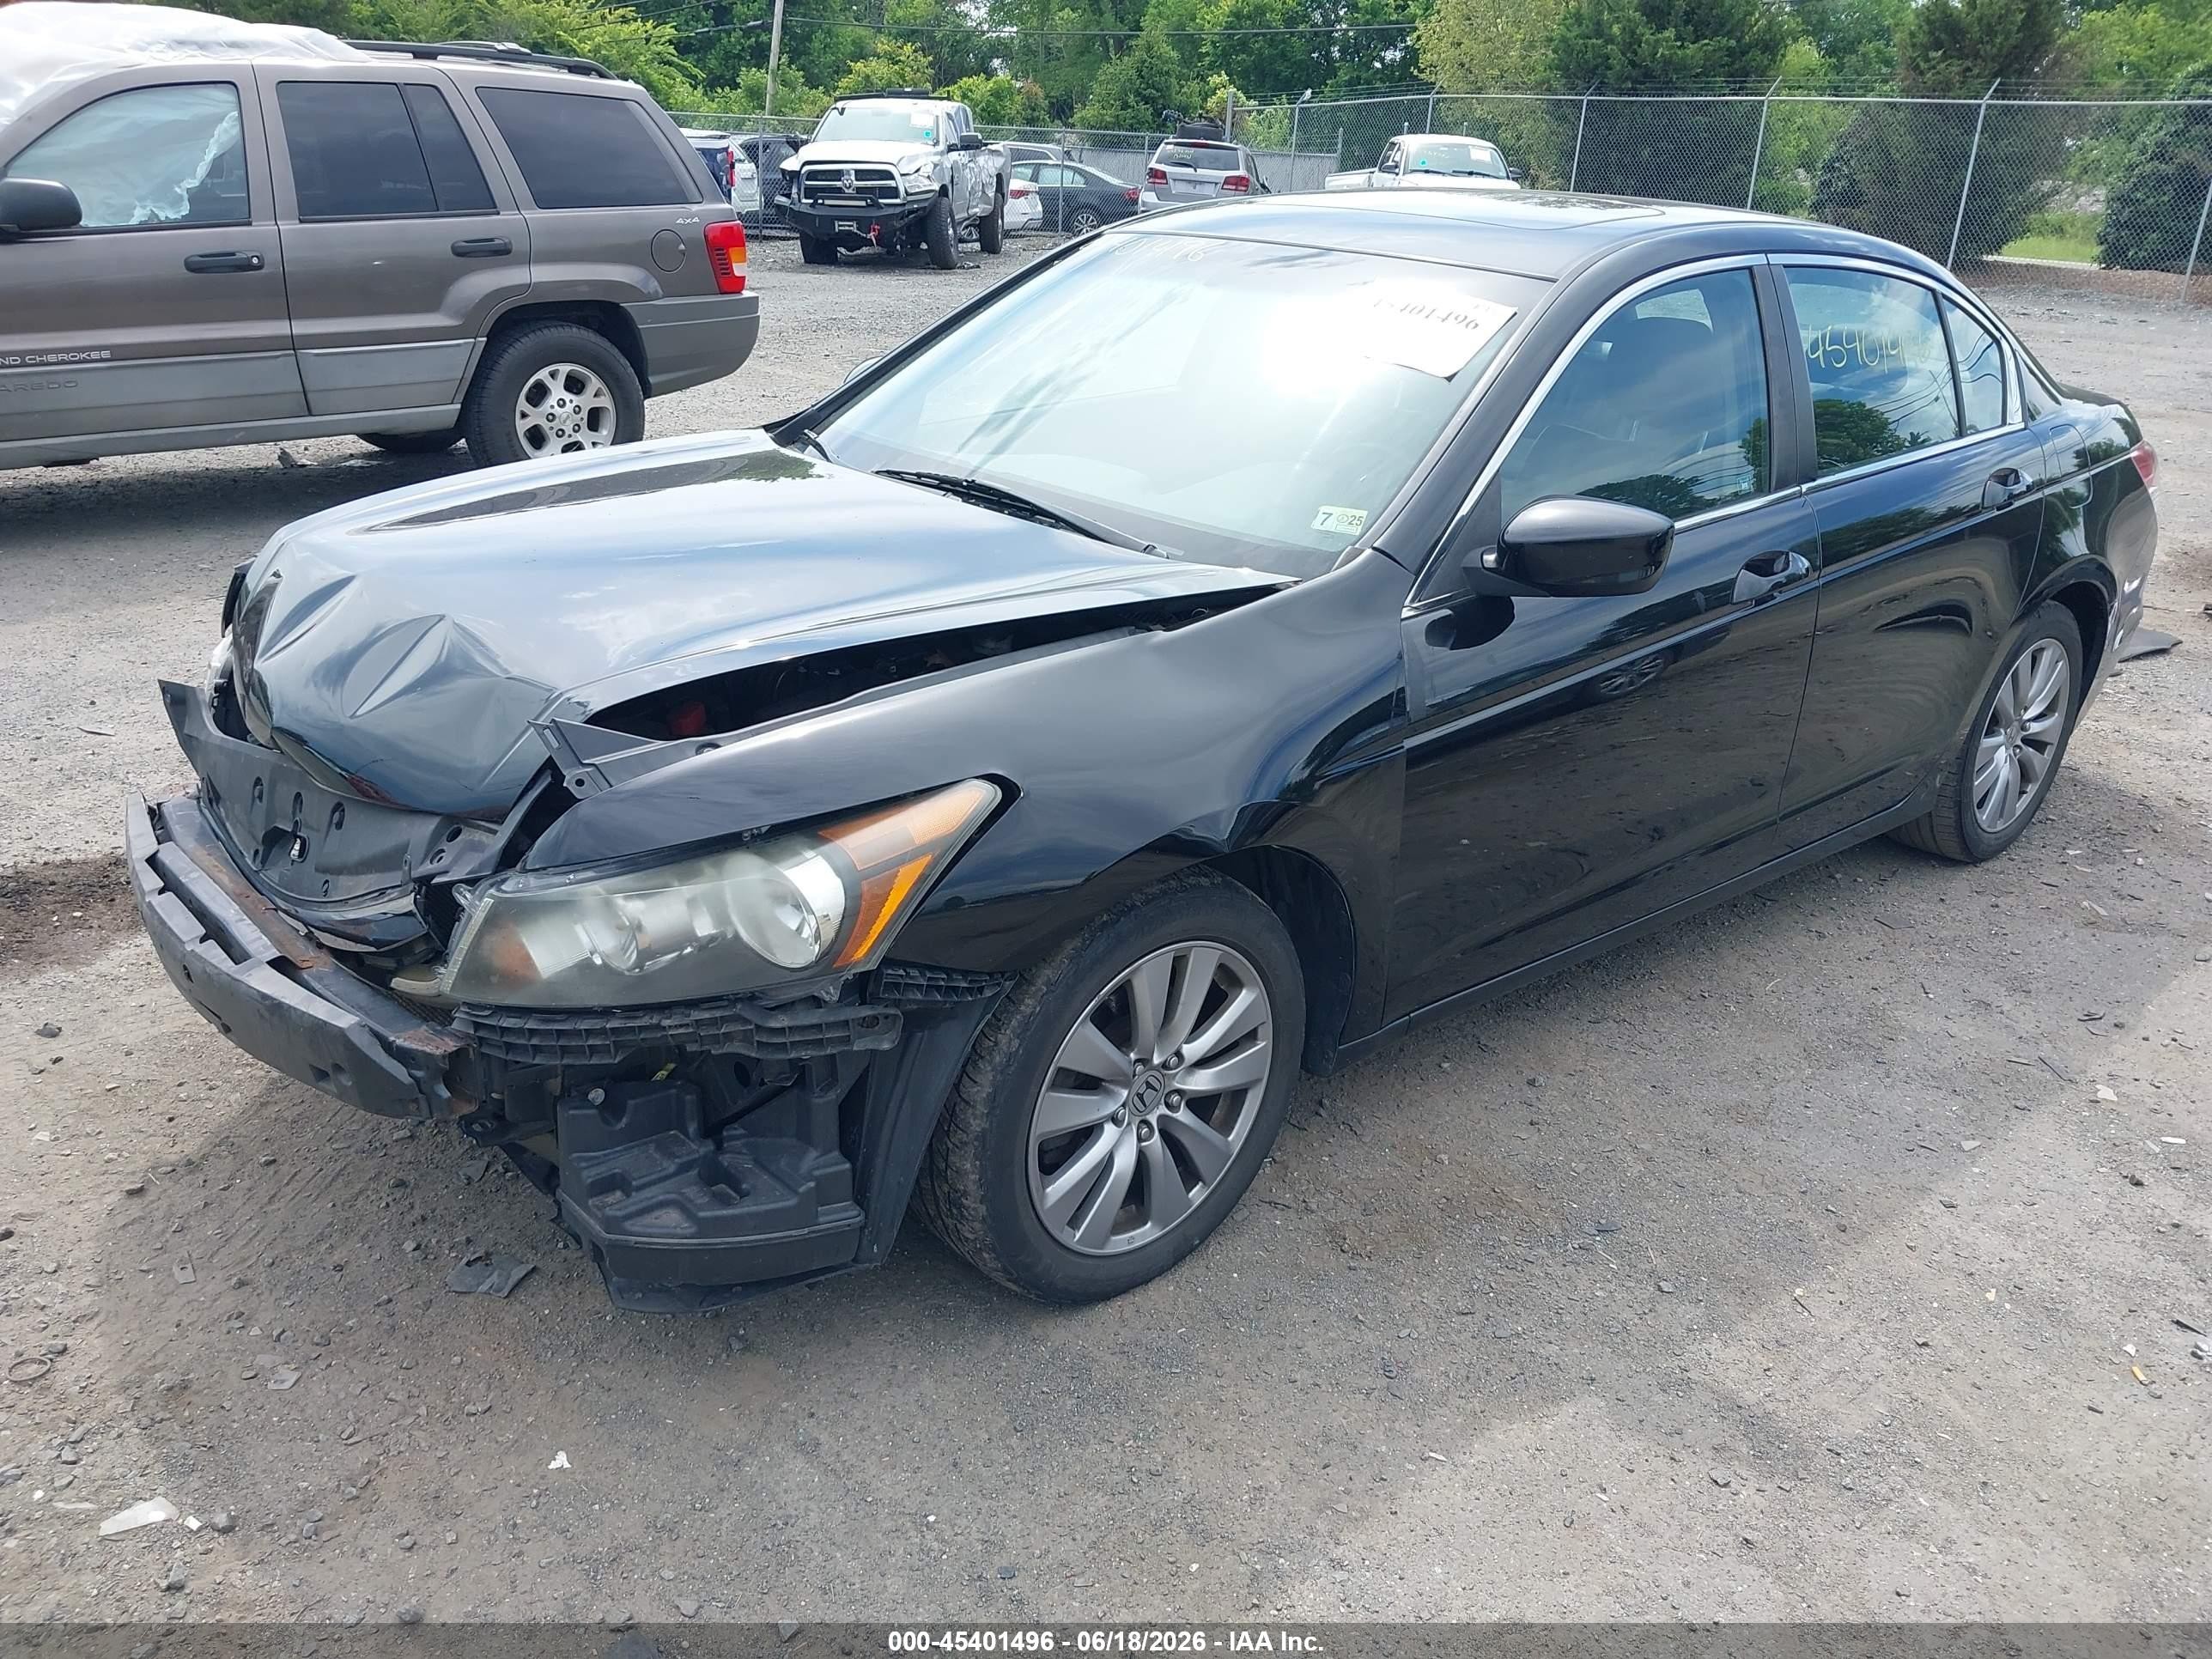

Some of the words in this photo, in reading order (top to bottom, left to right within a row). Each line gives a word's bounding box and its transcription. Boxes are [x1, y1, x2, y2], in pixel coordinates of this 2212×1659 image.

[26, 350, 112, 363] CHEROKEE
[1320, 512, 1333, 526] 7
[1347, 514, 1364, 526] 25
